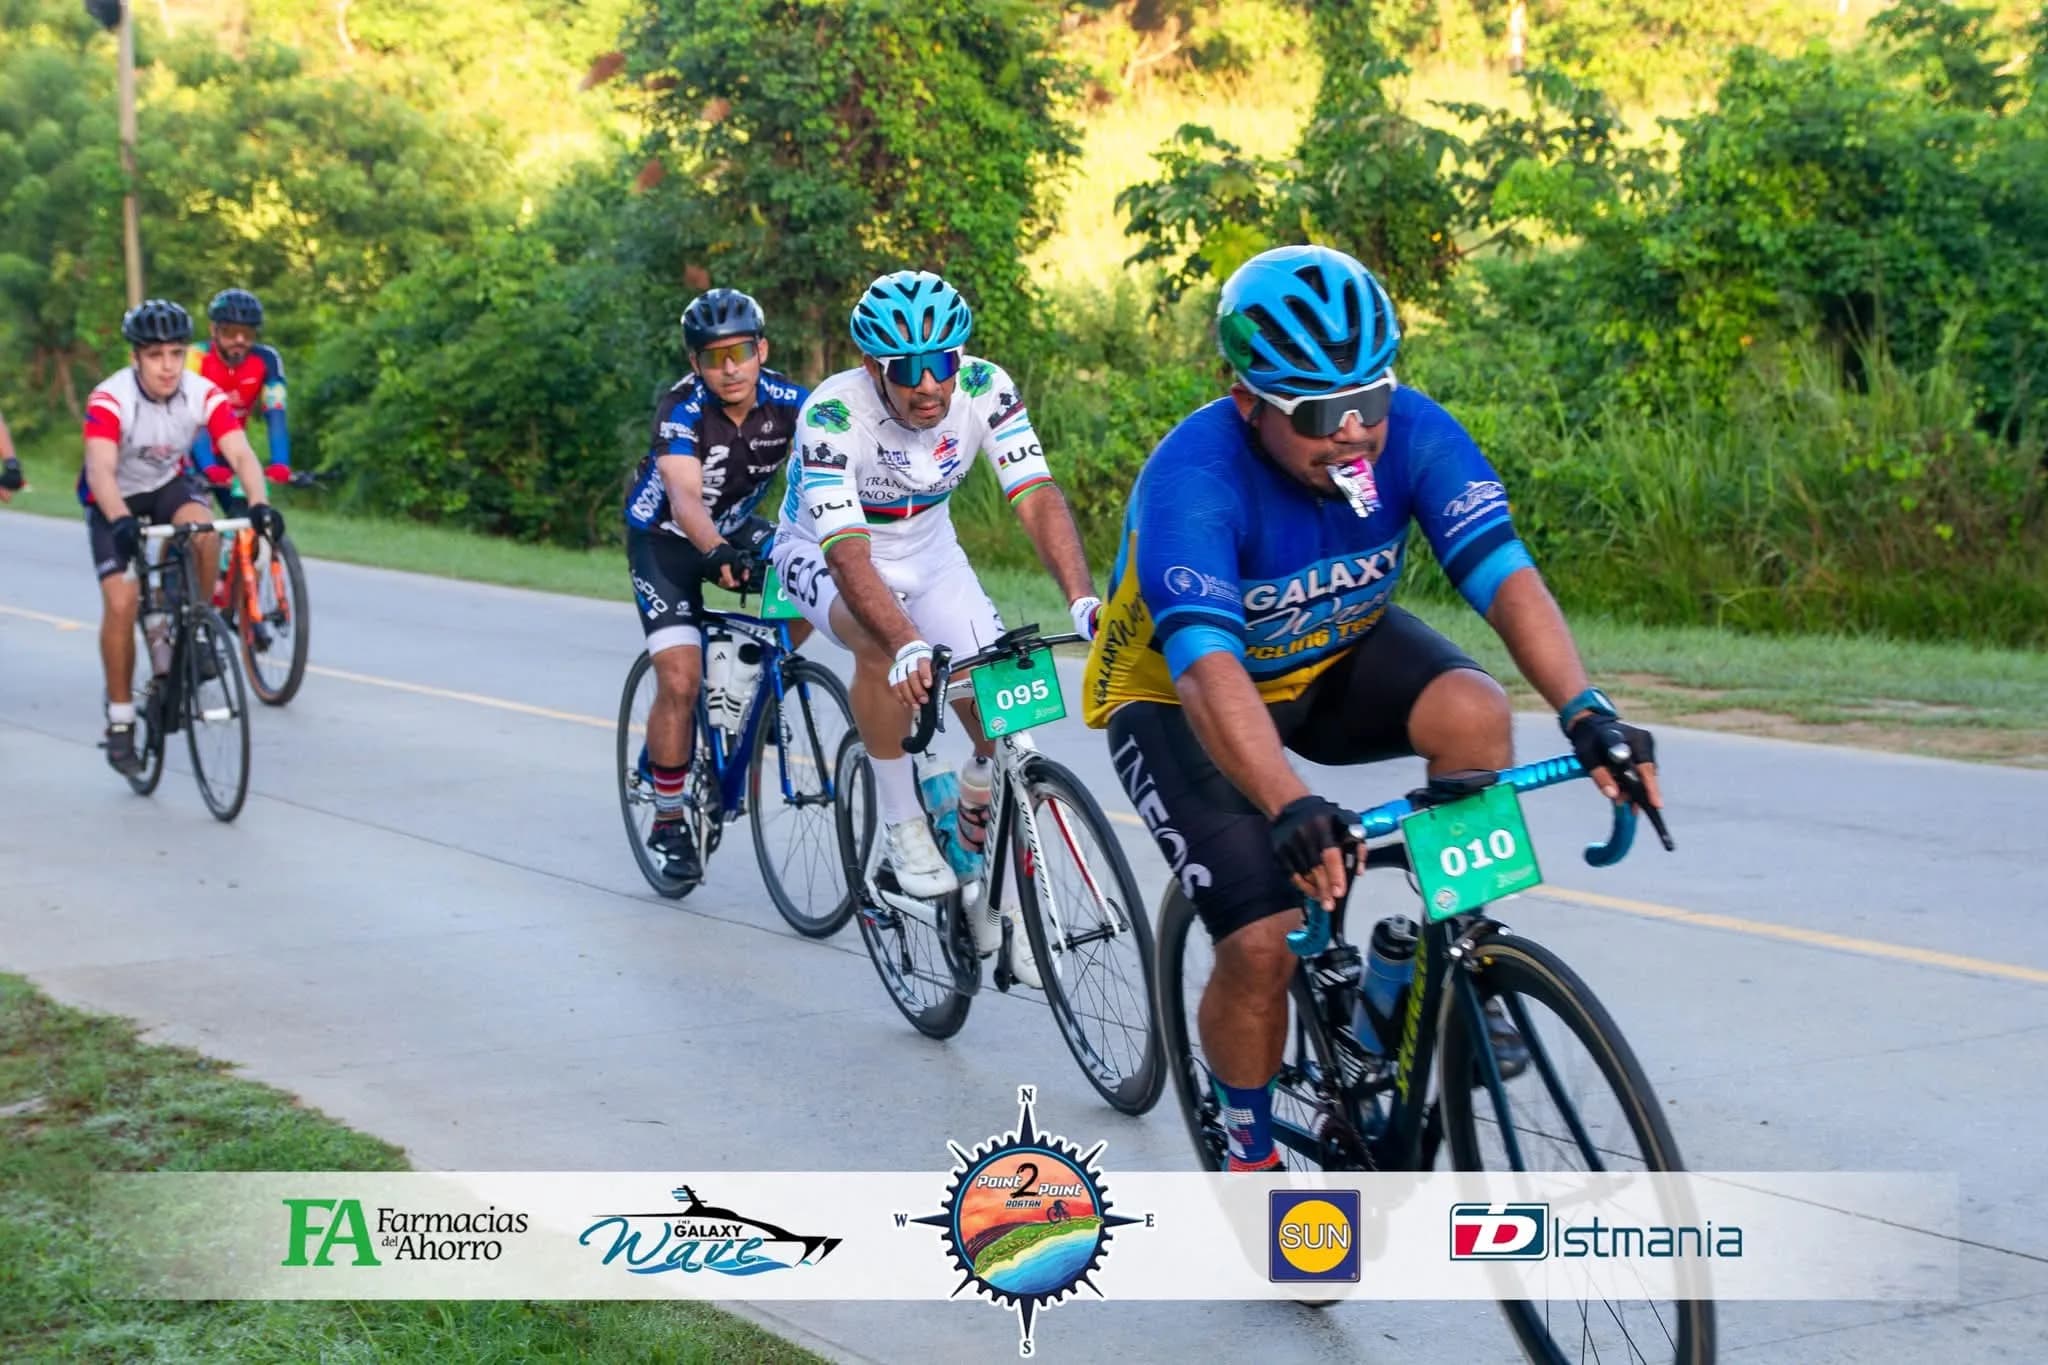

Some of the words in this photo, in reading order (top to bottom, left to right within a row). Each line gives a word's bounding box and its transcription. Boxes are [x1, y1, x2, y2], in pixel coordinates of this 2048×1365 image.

[1007, 444, 1042, 463] UC
[784, 556, 832, 608] EOS
[1244, 543, 1401, 611] GALAXY
[996, 679, 1049, 710] 095
[1112, 734, 1212, 899] INEOS
[1440, 829, 1516, 877] 010
